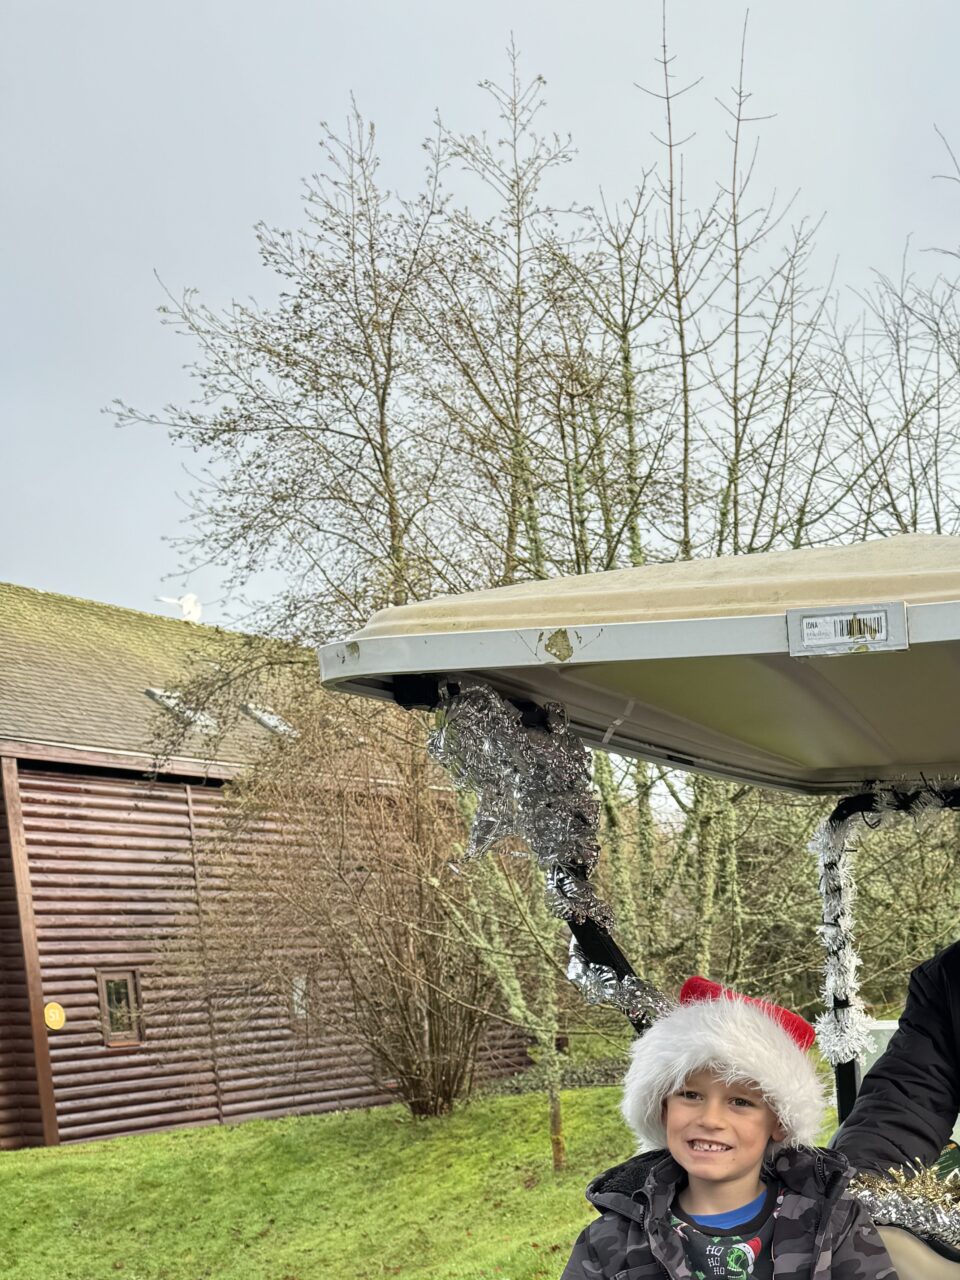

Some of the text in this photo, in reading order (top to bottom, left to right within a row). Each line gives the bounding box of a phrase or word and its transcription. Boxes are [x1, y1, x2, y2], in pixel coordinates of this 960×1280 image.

[705, 1245, 724, 1257] HO
[707, 1257, 720, 1267] HO
[713, 1266, 725, 1275] HO
